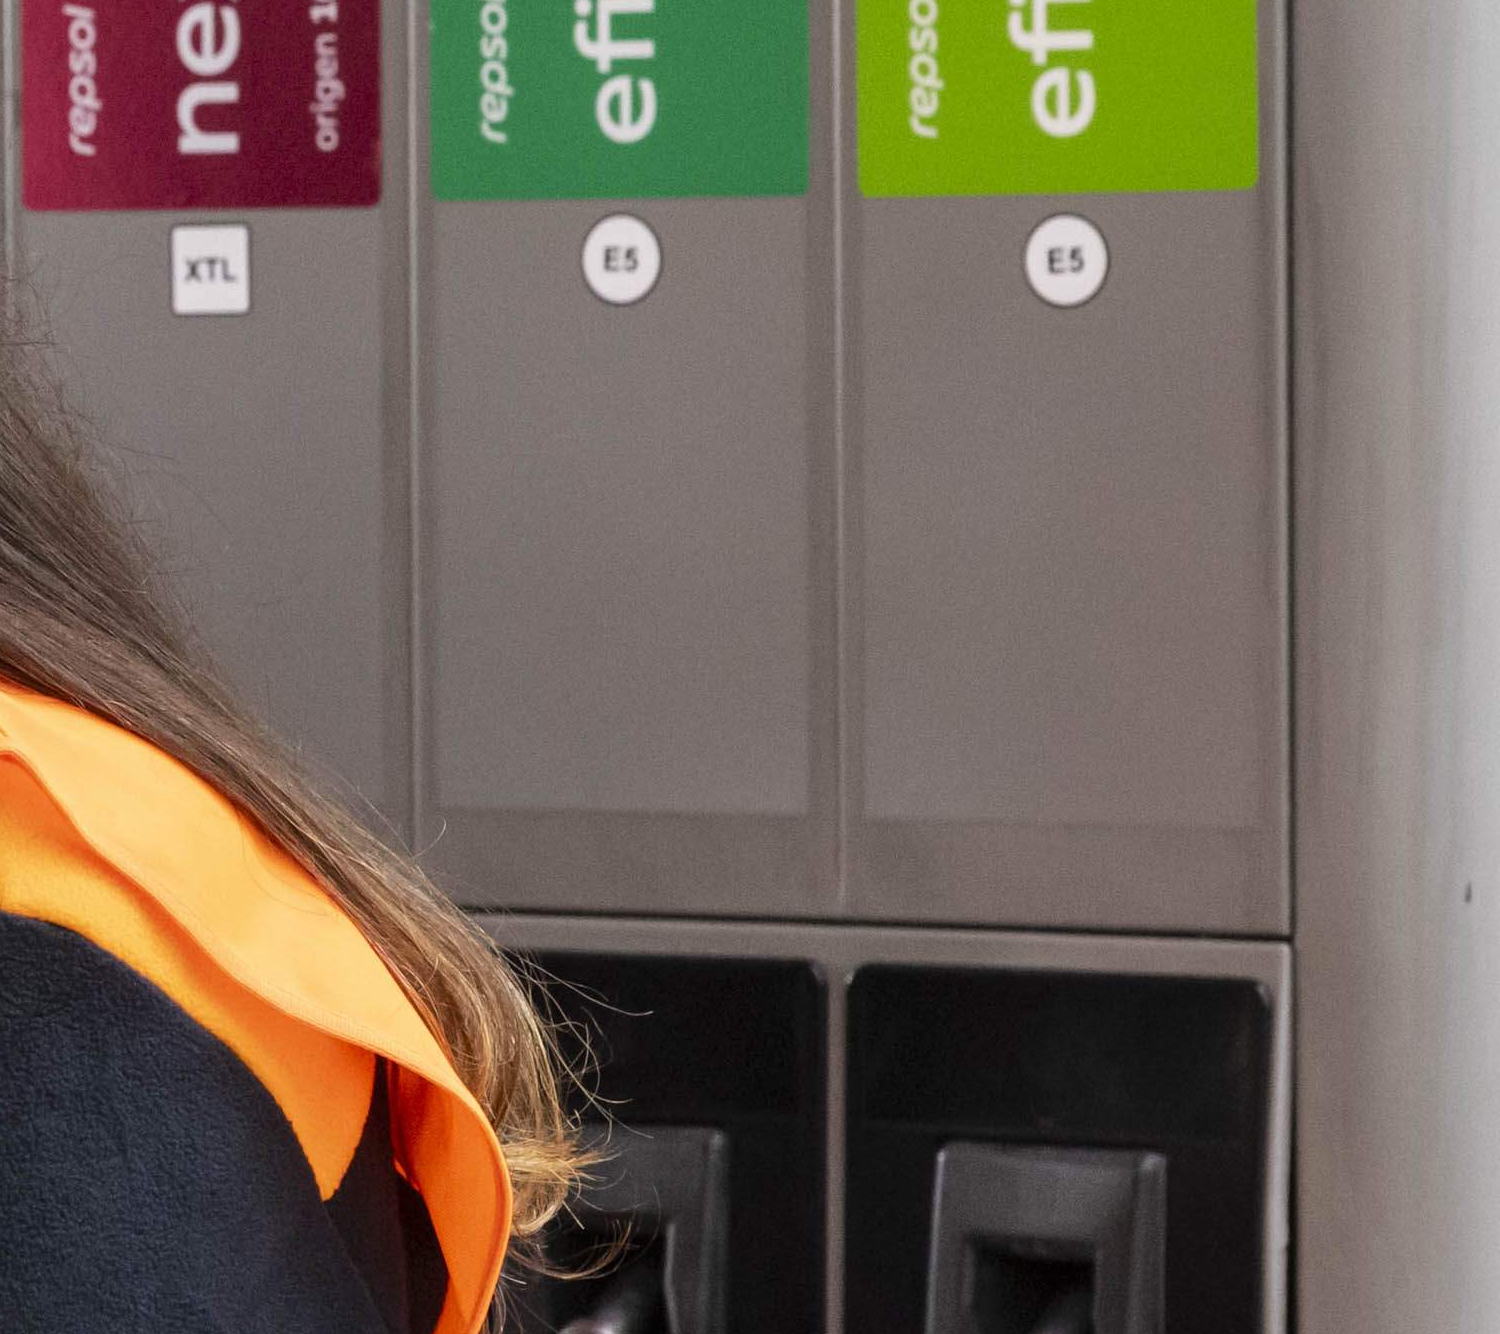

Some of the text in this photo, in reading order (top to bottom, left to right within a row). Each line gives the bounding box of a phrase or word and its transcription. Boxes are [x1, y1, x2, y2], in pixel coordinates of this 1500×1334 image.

[62, 3, 101, 157] repsol
[307, 31, 342, 153] origen
[185, 256, 235, 284] XTL
[602, 246, 639, 273] E5
[1046, 246, 1086, 275] E5
